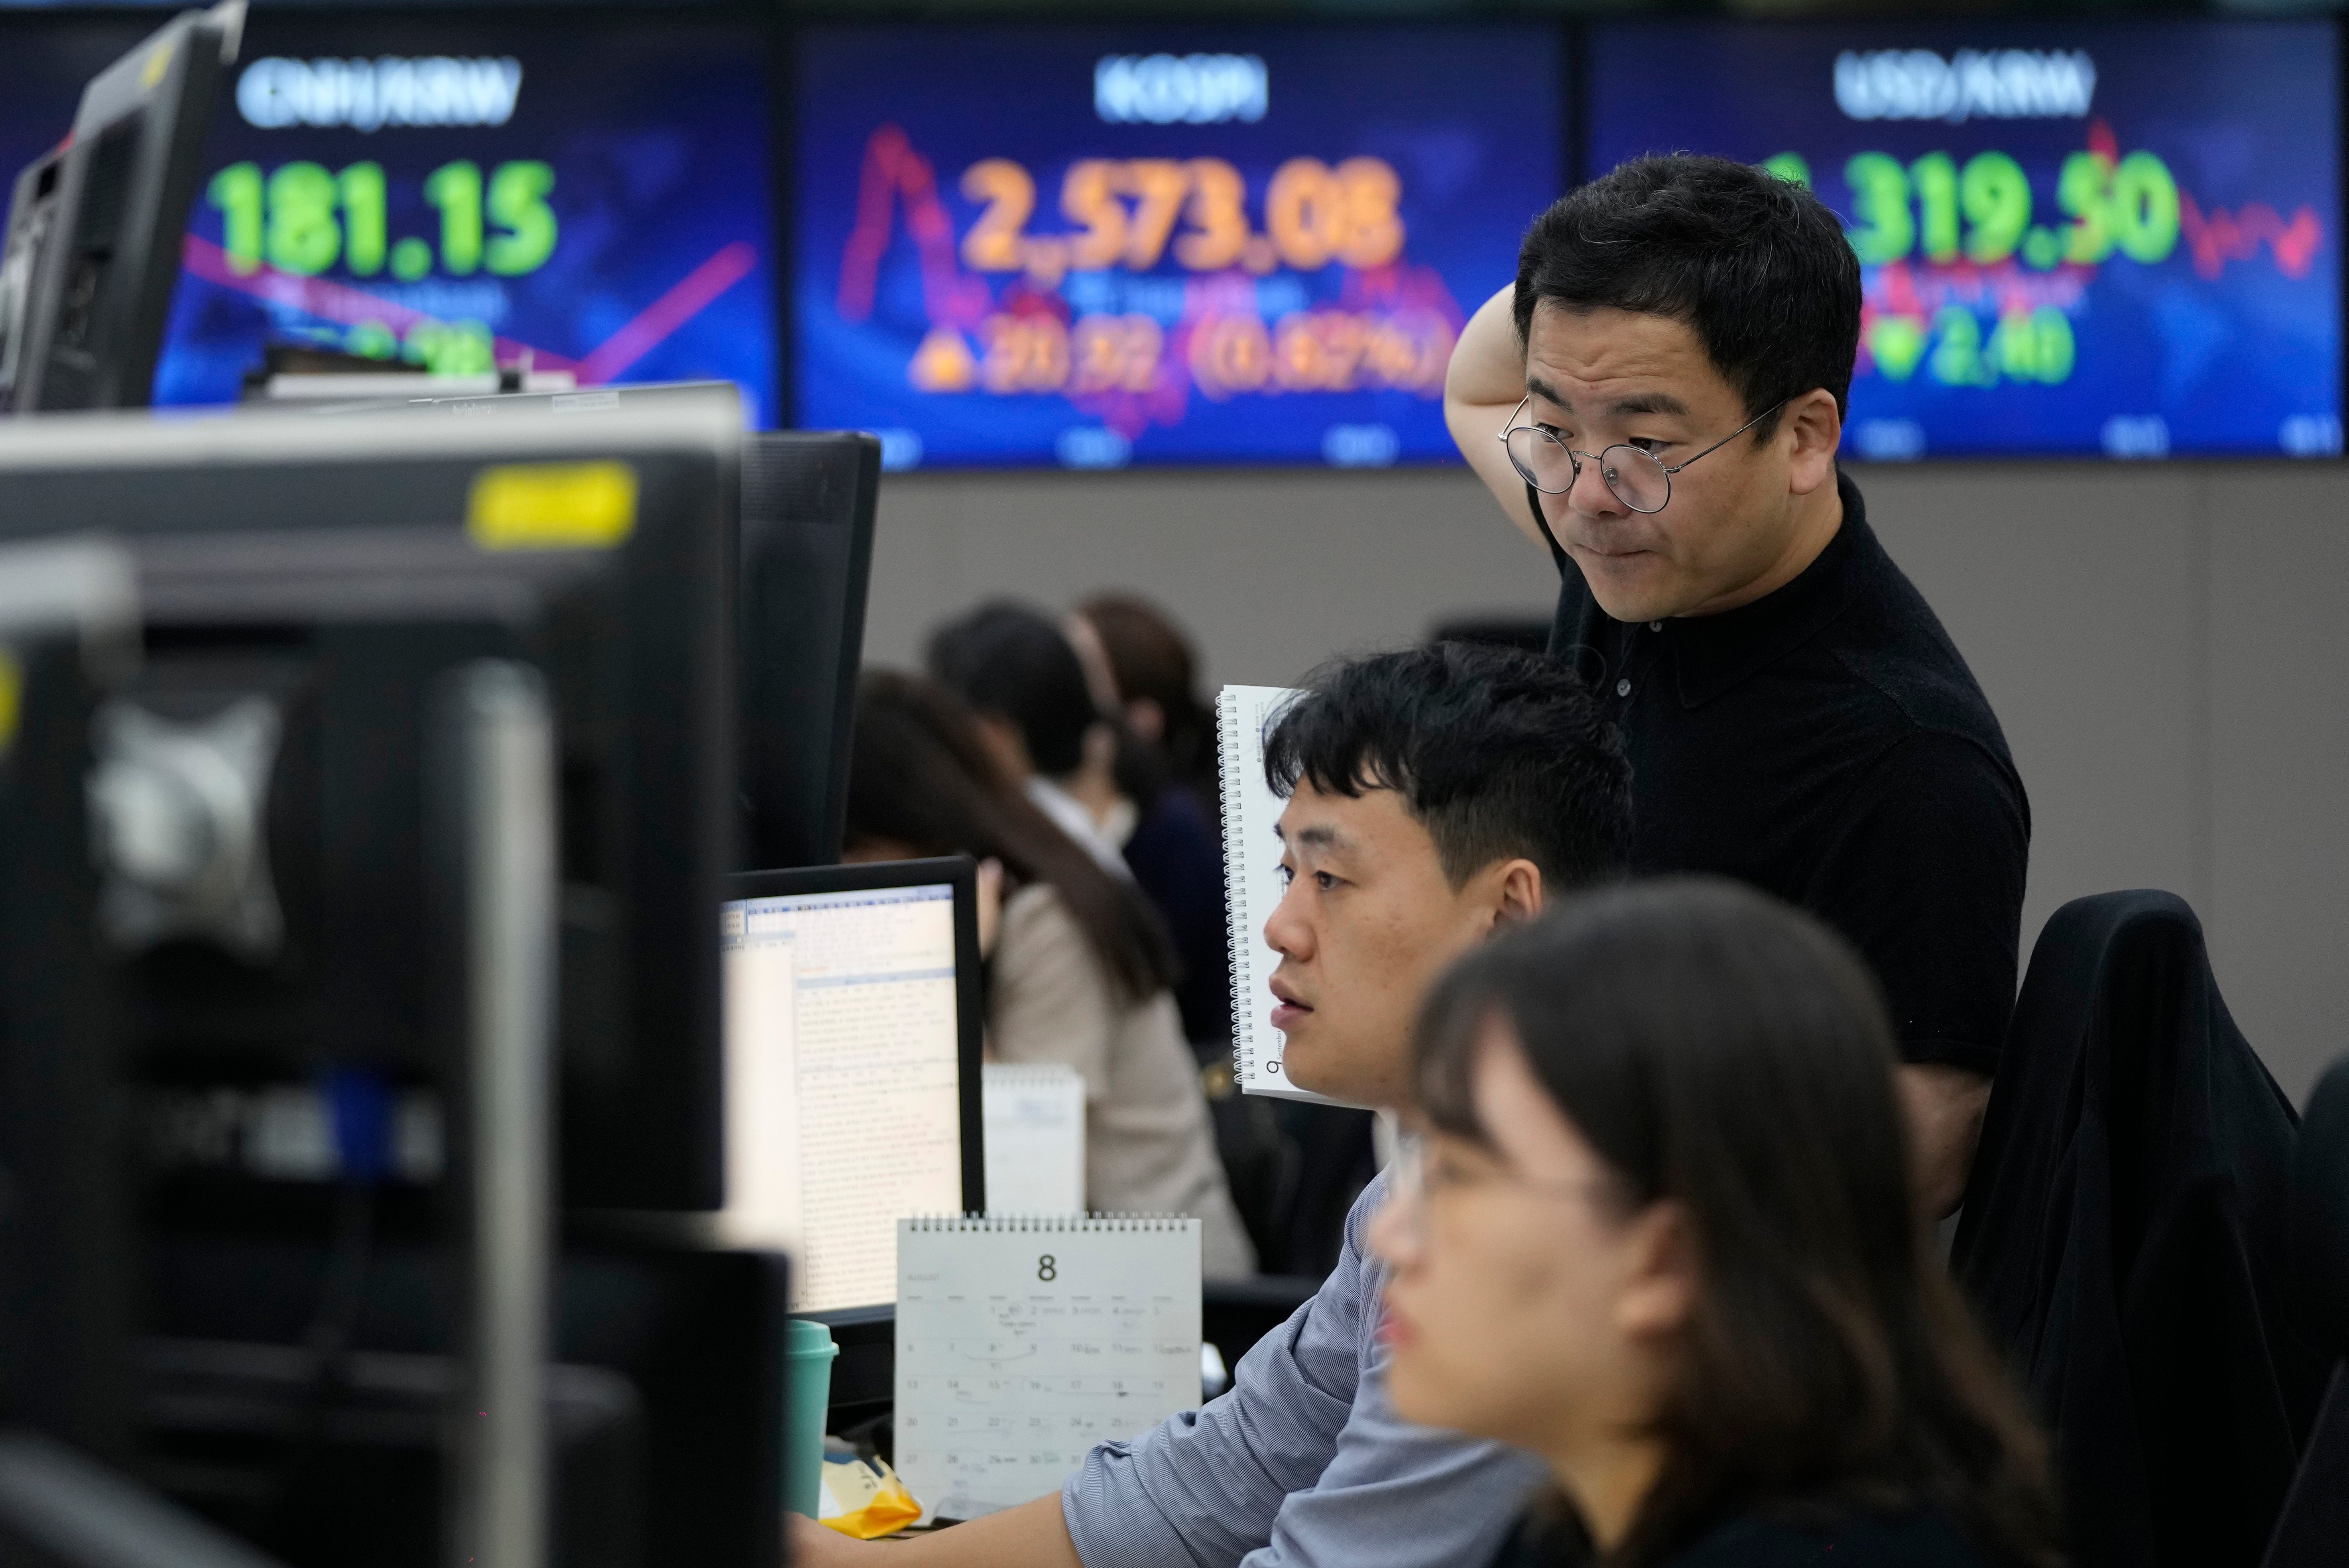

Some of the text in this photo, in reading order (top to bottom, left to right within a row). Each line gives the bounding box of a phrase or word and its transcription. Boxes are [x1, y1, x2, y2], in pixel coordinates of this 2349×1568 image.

[1094, 53, 1269, 124] KOSPI
[1833, 48, 2097, 123] USD/KRW
[207, 159, 557, 281] 181.15
[959, 156, 1405, 285] 2,573.08
[1762, 151, 2180, 272] 319.50
[1267, 1061, 1283, 1073] 9
[1038, 1255, 1056, 1281] 8
